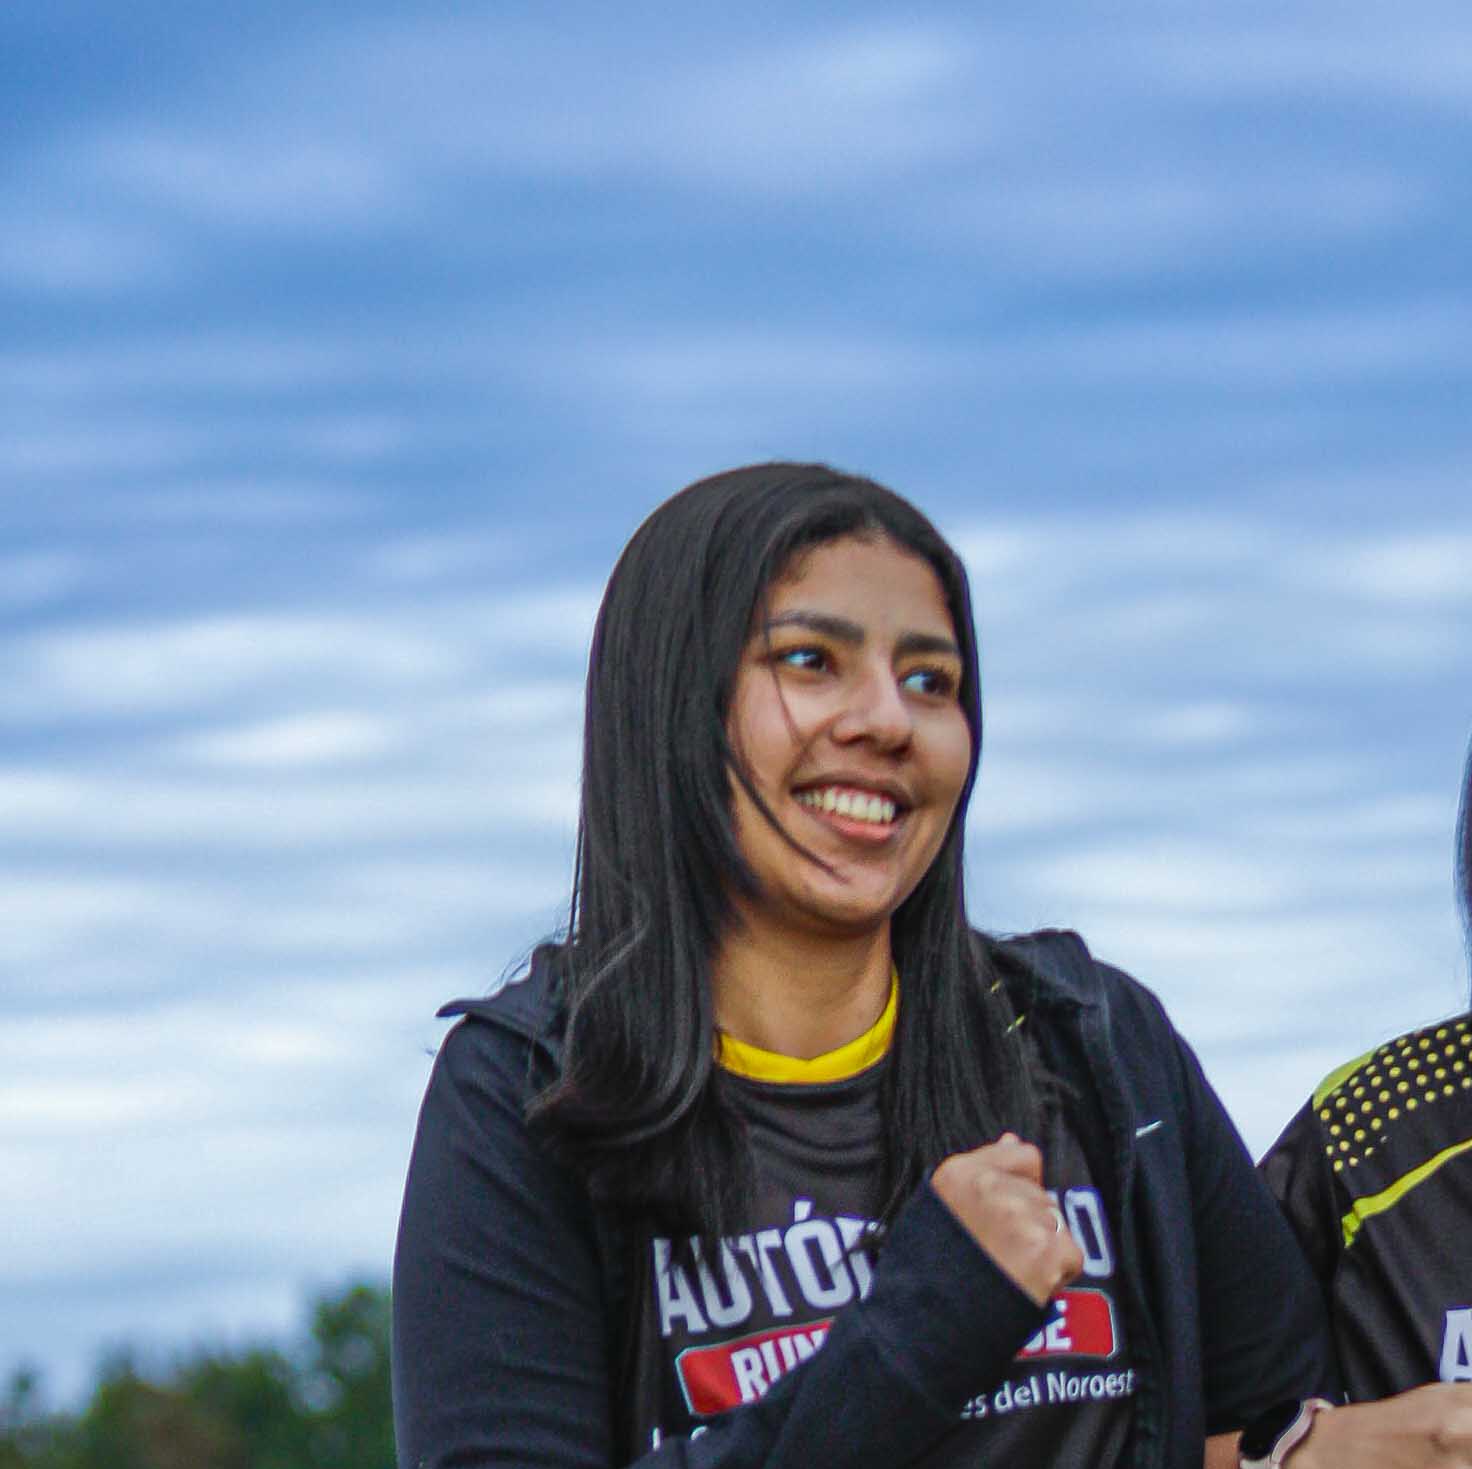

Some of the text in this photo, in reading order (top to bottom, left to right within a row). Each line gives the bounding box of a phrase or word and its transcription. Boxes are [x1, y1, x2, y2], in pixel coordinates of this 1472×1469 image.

[653, 1185, 1112, 1337] AUTÓO
[994, 1376, 1041, 1413] del
[1047, 1369, 1134, 1402] Noroest
